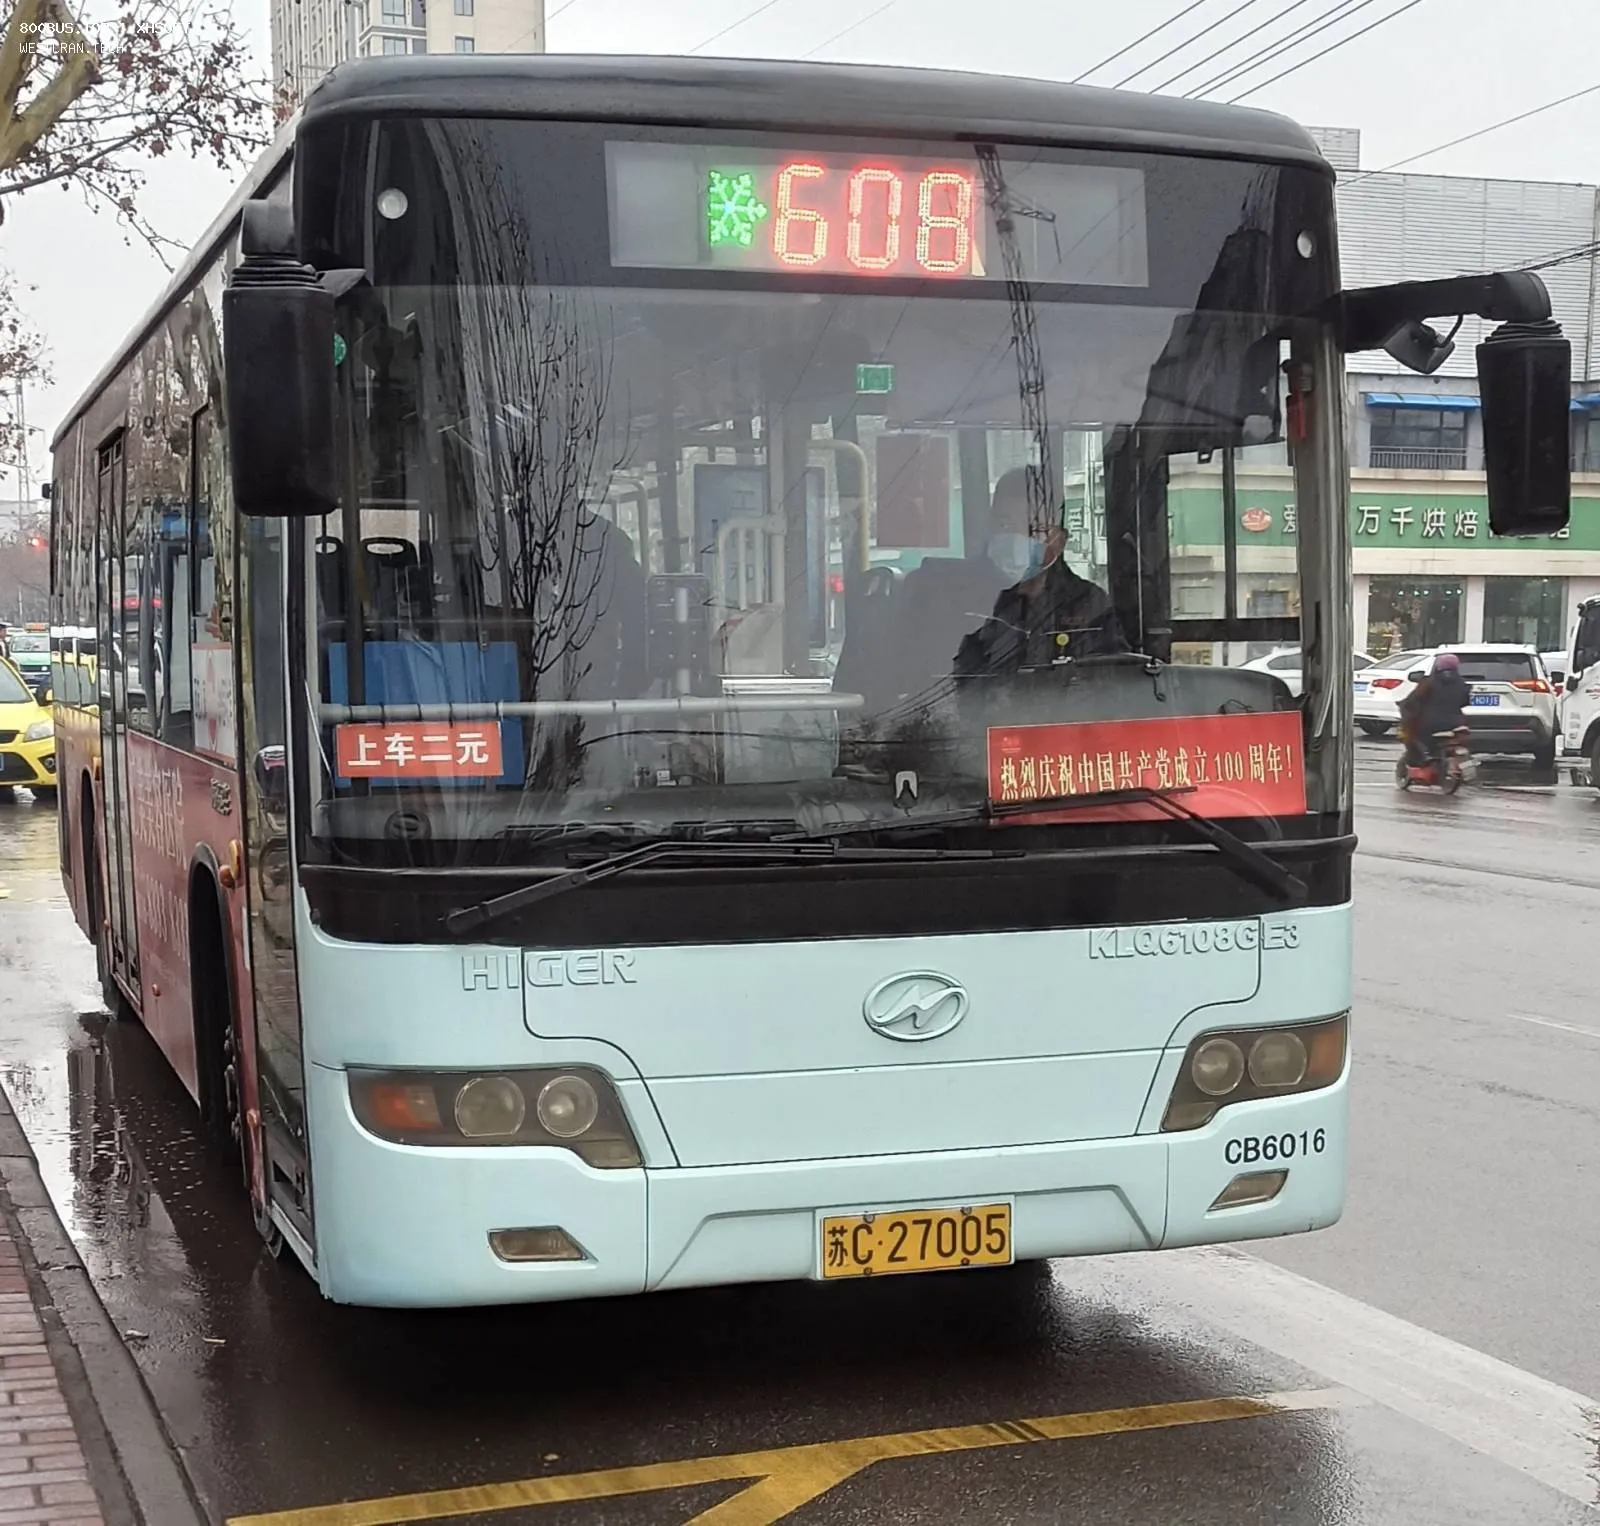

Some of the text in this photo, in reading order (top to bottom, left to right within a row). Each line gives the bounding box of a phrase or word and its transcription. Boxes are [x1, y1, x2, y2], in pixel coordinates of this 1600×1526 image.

[774, 163, 972, 272] 608
[348, 732, 489, 767] 上车二元
[462, 950, 637, 992] HIGER
[1224, 1127, 1325, 1165] CB6016
